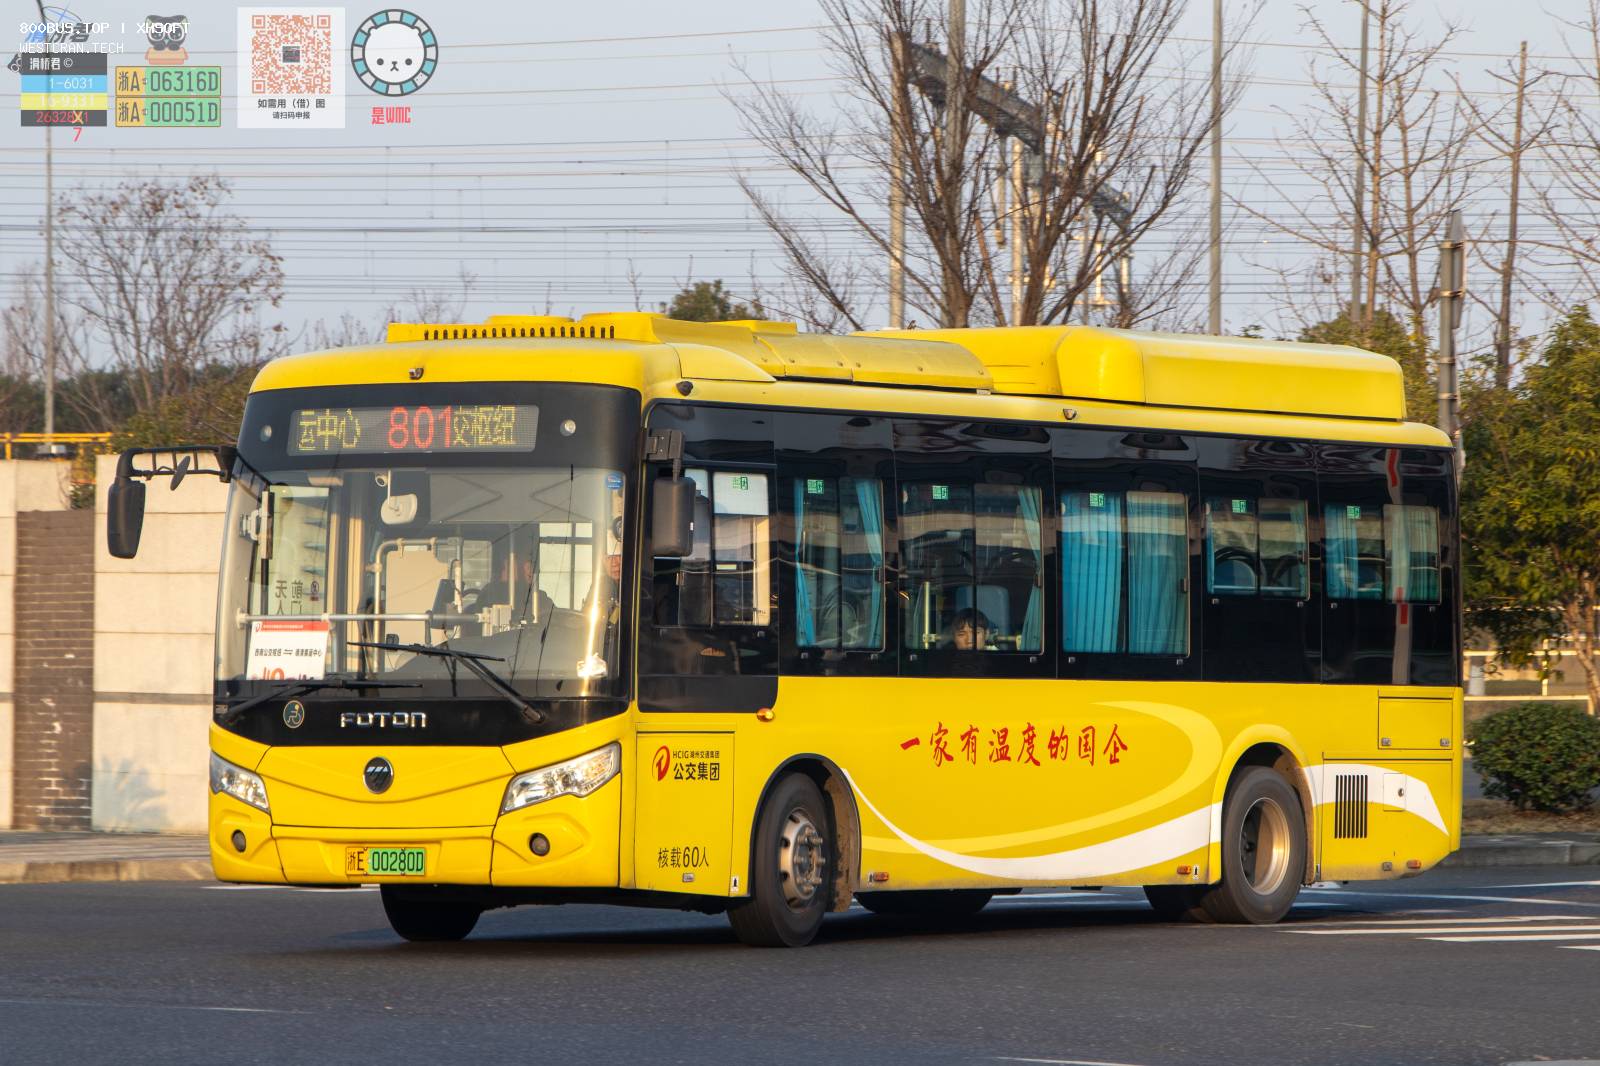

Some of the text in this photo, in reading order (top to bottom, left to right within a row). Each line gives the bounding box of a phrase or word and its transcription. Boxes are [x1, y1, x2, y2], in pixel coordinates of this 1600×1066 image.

[386, 405, 453, 449] 801
[339, 712, 427, 728] FOTON
[899, 721, 1129, 768] 一家有温度的国企
[673, 761, 720, 781] 公交集团
[657, 846, 710, 869] 核载60人
